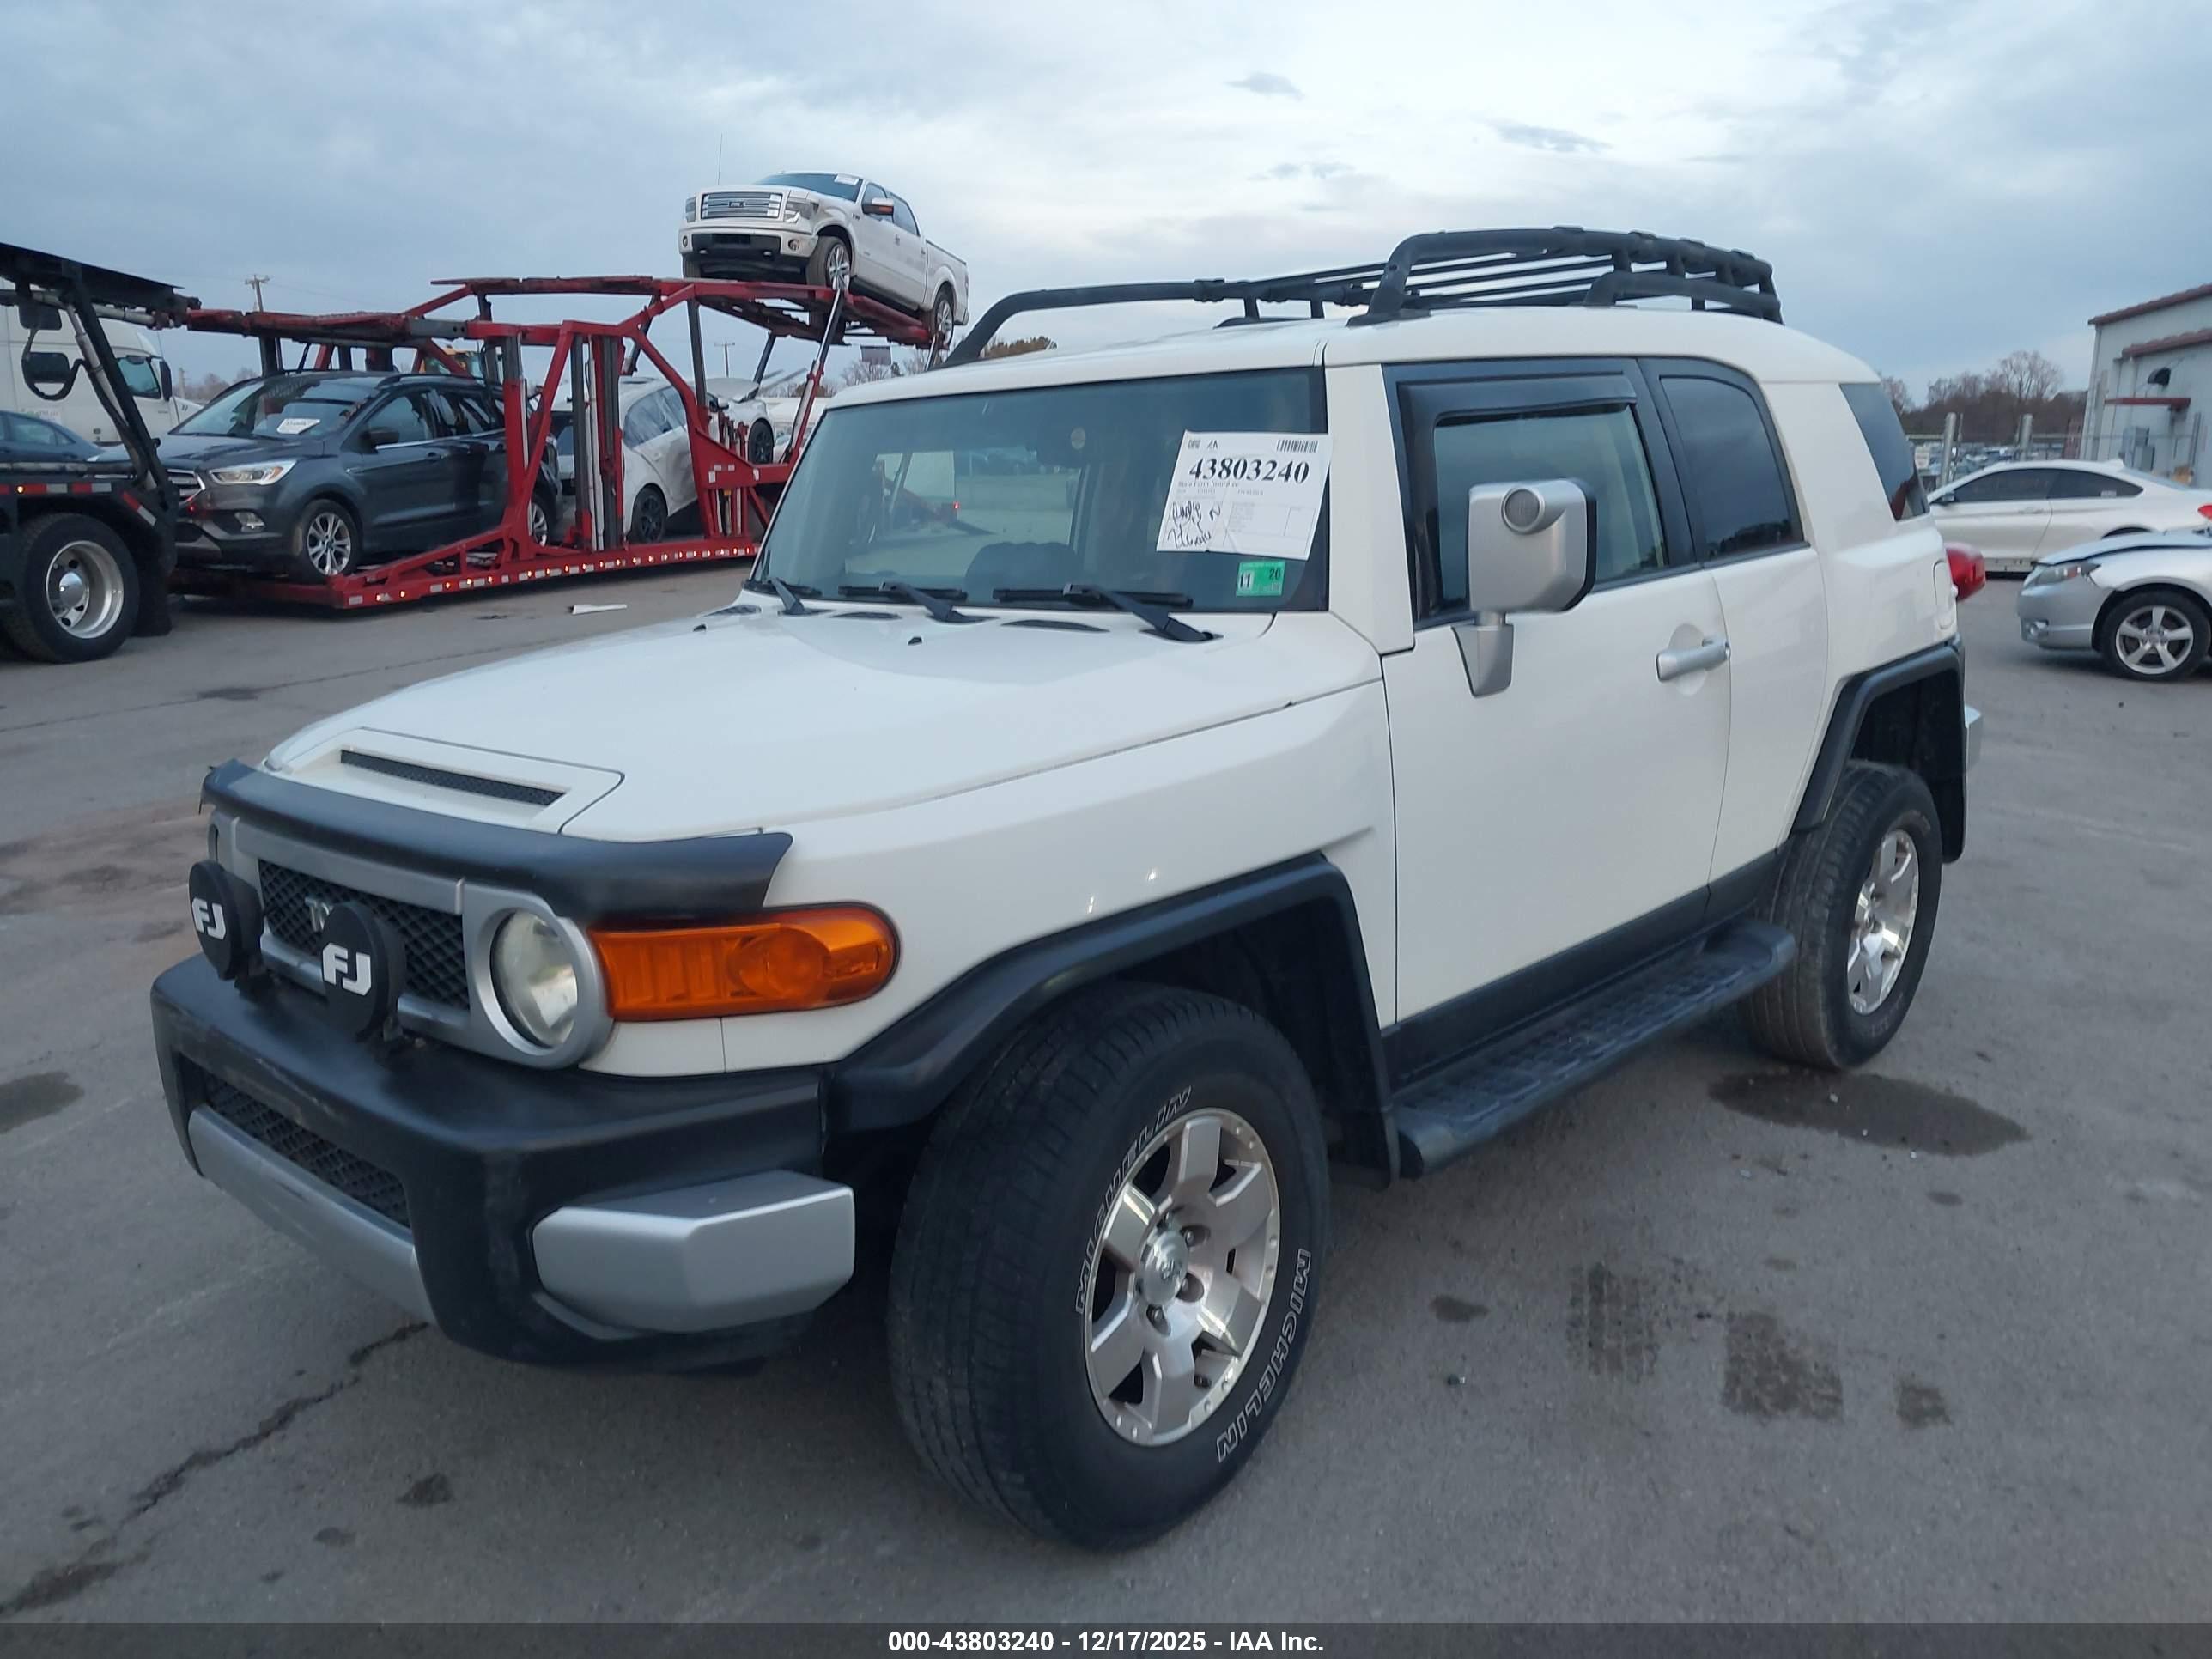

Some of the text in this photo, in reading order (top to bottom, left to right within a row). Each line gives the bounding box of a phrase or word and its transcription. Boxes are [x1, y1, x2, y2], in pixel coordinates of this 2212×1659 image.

[1189, 457, 1310, 484] 43803240
[191, 897, 227, 940] FJ
[322, 942, 372, 996] FJ
[1075, 1085, 1192, 1315] MICHELIN
[1217, 1248, 1311, 1463] MICHELIN
